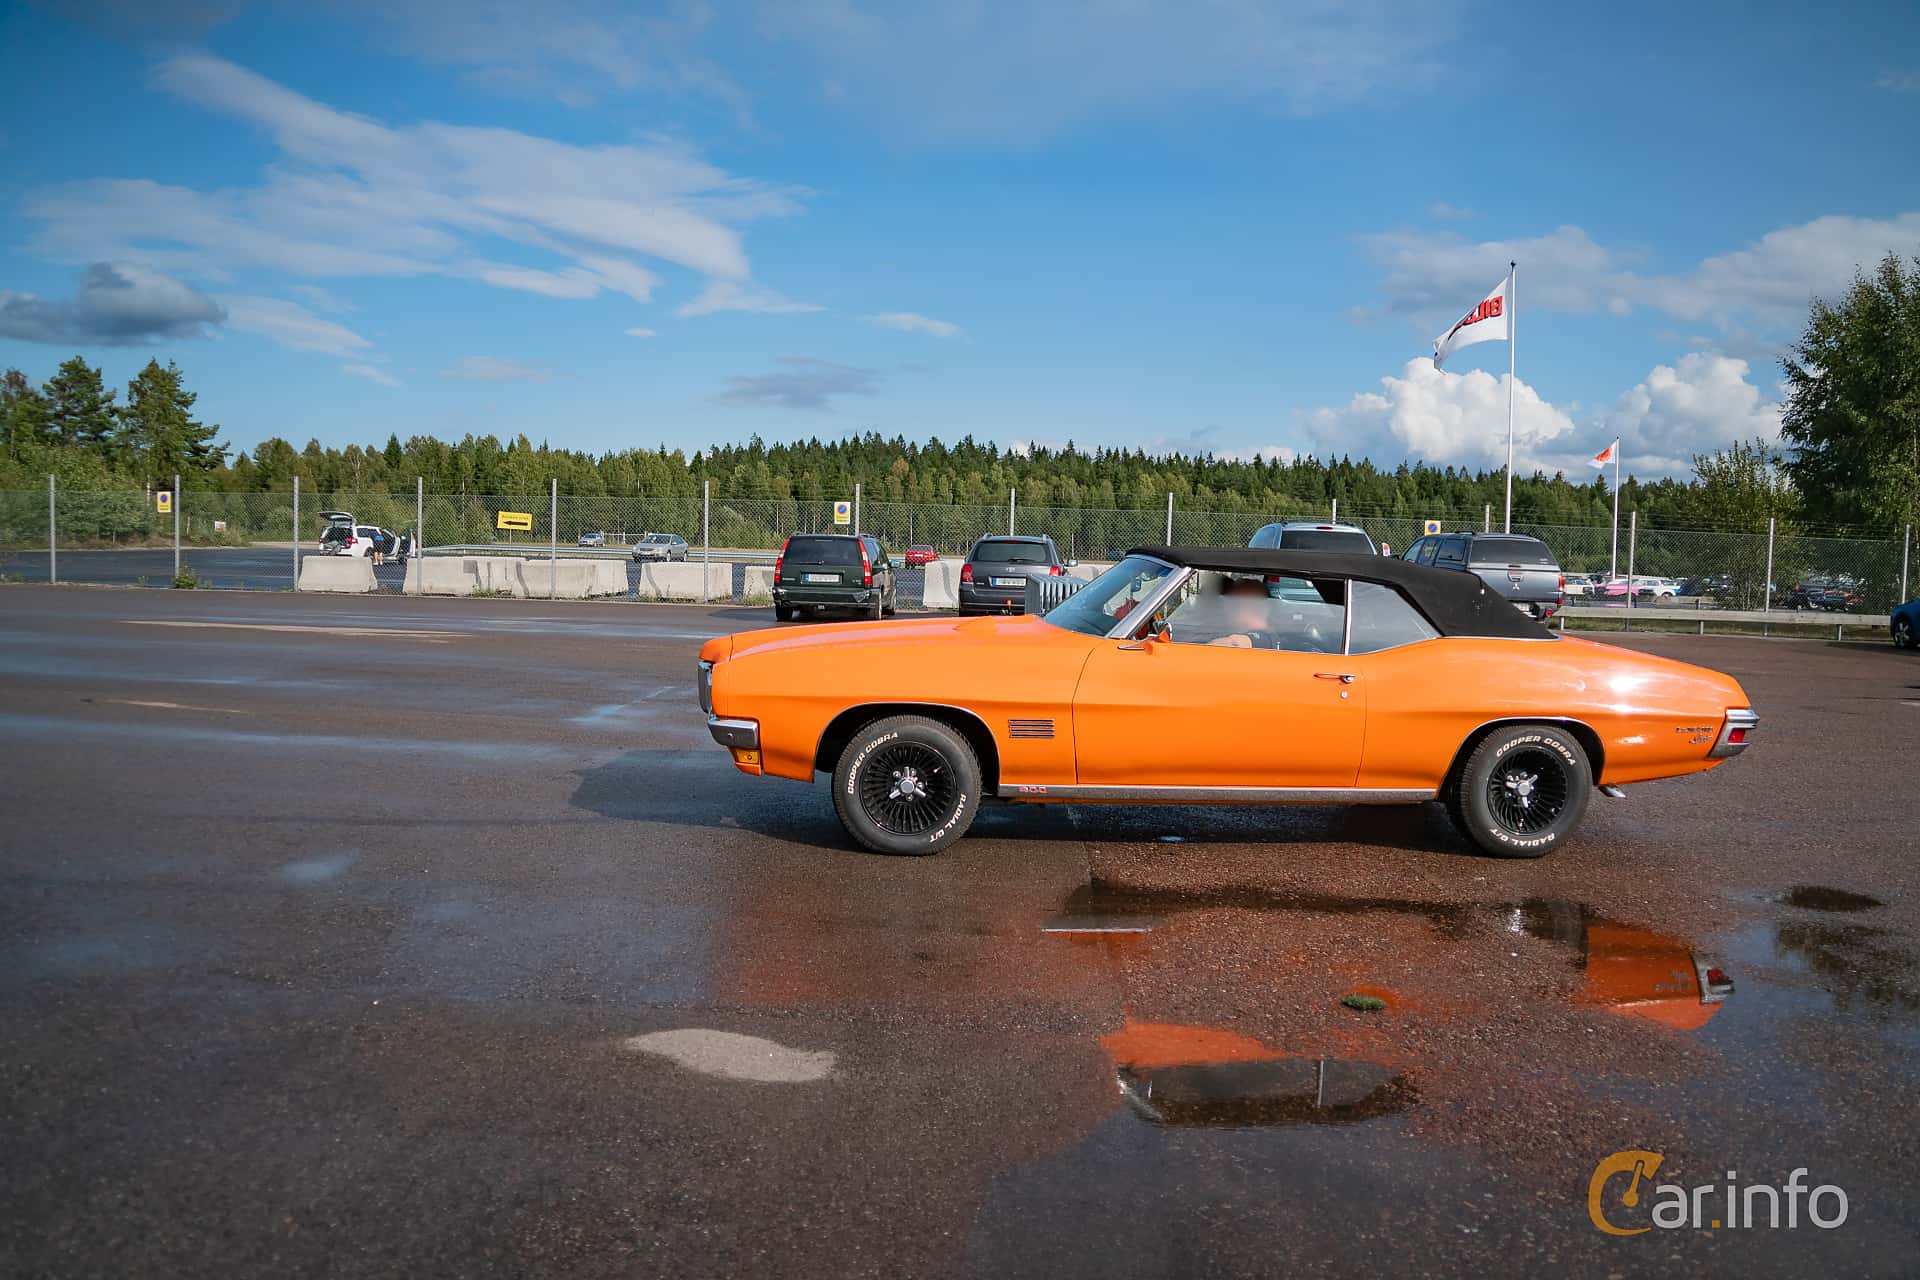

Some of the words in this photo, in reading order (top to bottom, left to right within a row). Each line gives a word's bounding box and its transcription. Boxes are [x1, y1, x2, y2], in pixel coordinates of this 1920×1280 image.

[847, 754, 865, 795] COOPER
[865, 732, 898, 753] COBRA
[1496, 735, 1541, 757] COOPER
[1543, 737, 1576, 766] COBRA
[945, 793, 967, 830] RADIAL
[1511, 833, 1555, 847] RADIAL
